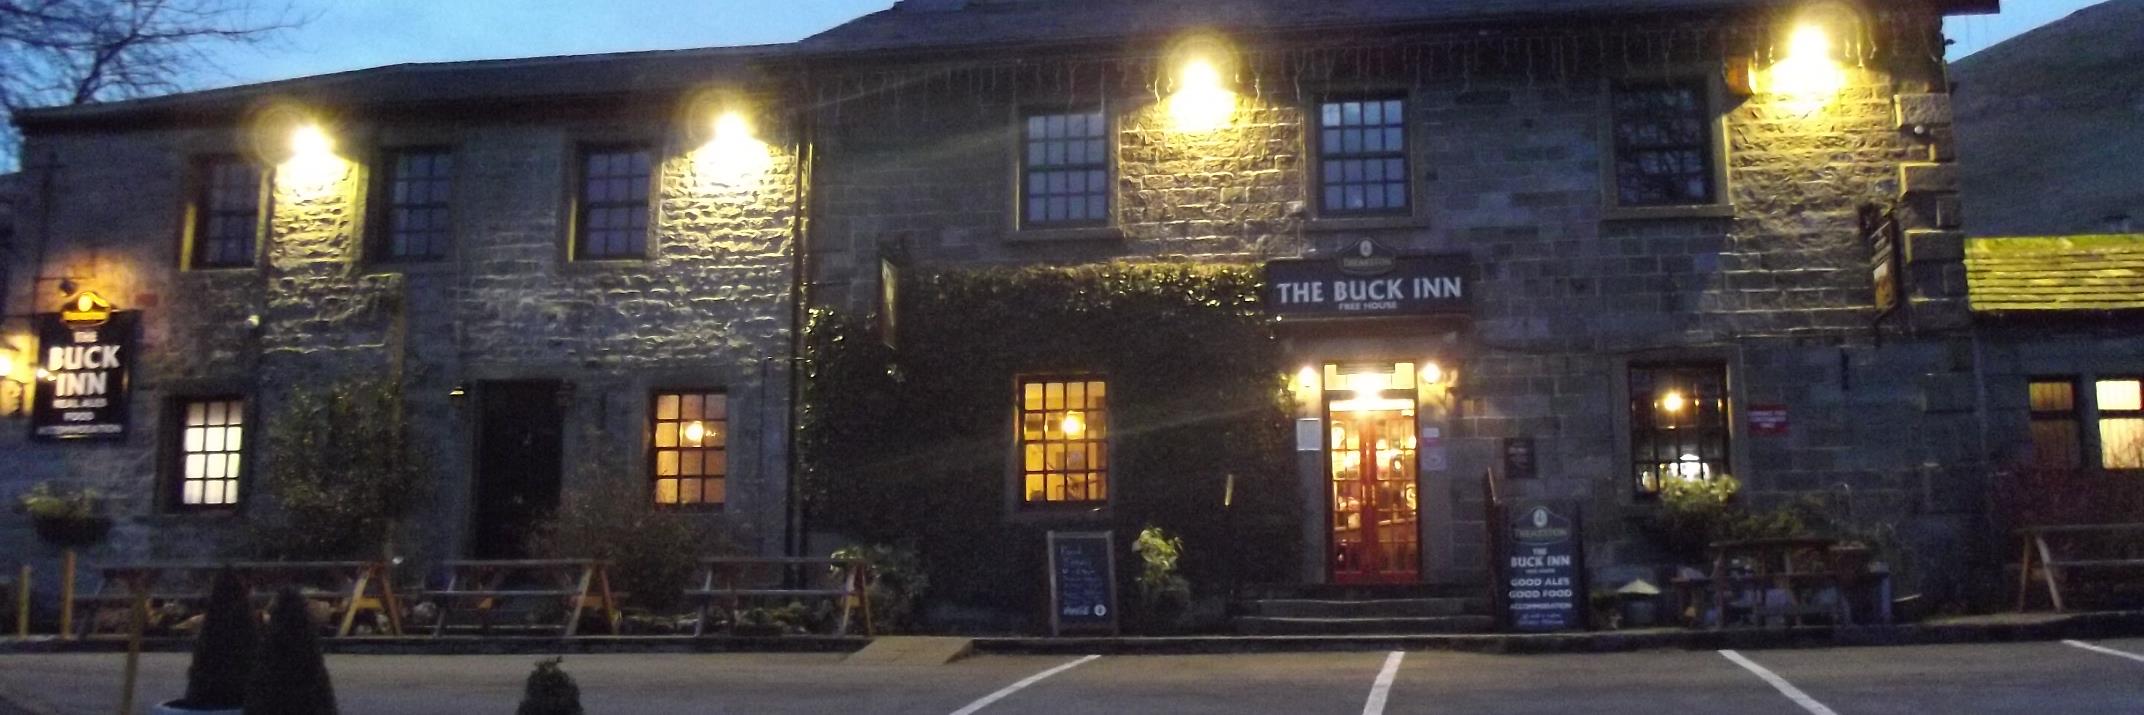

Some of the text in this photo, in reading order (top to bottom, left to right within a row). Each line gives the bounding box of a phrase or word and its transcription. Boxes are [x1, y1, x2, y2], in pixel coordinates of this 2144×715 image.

[1276, 276, 1462, 303] THE BUCK INN
[1338, 301, 1398, 311] FREE HOUSE
[48, 345, 121, 370] BUCK
[56, 372, 107, 396] INN
[1510, 554, 1571, 568] BUCK INN
[1510, 577, 1570, 587] GOOD ALES
[1508, 589, 1573, 599] GOOD FOOD
